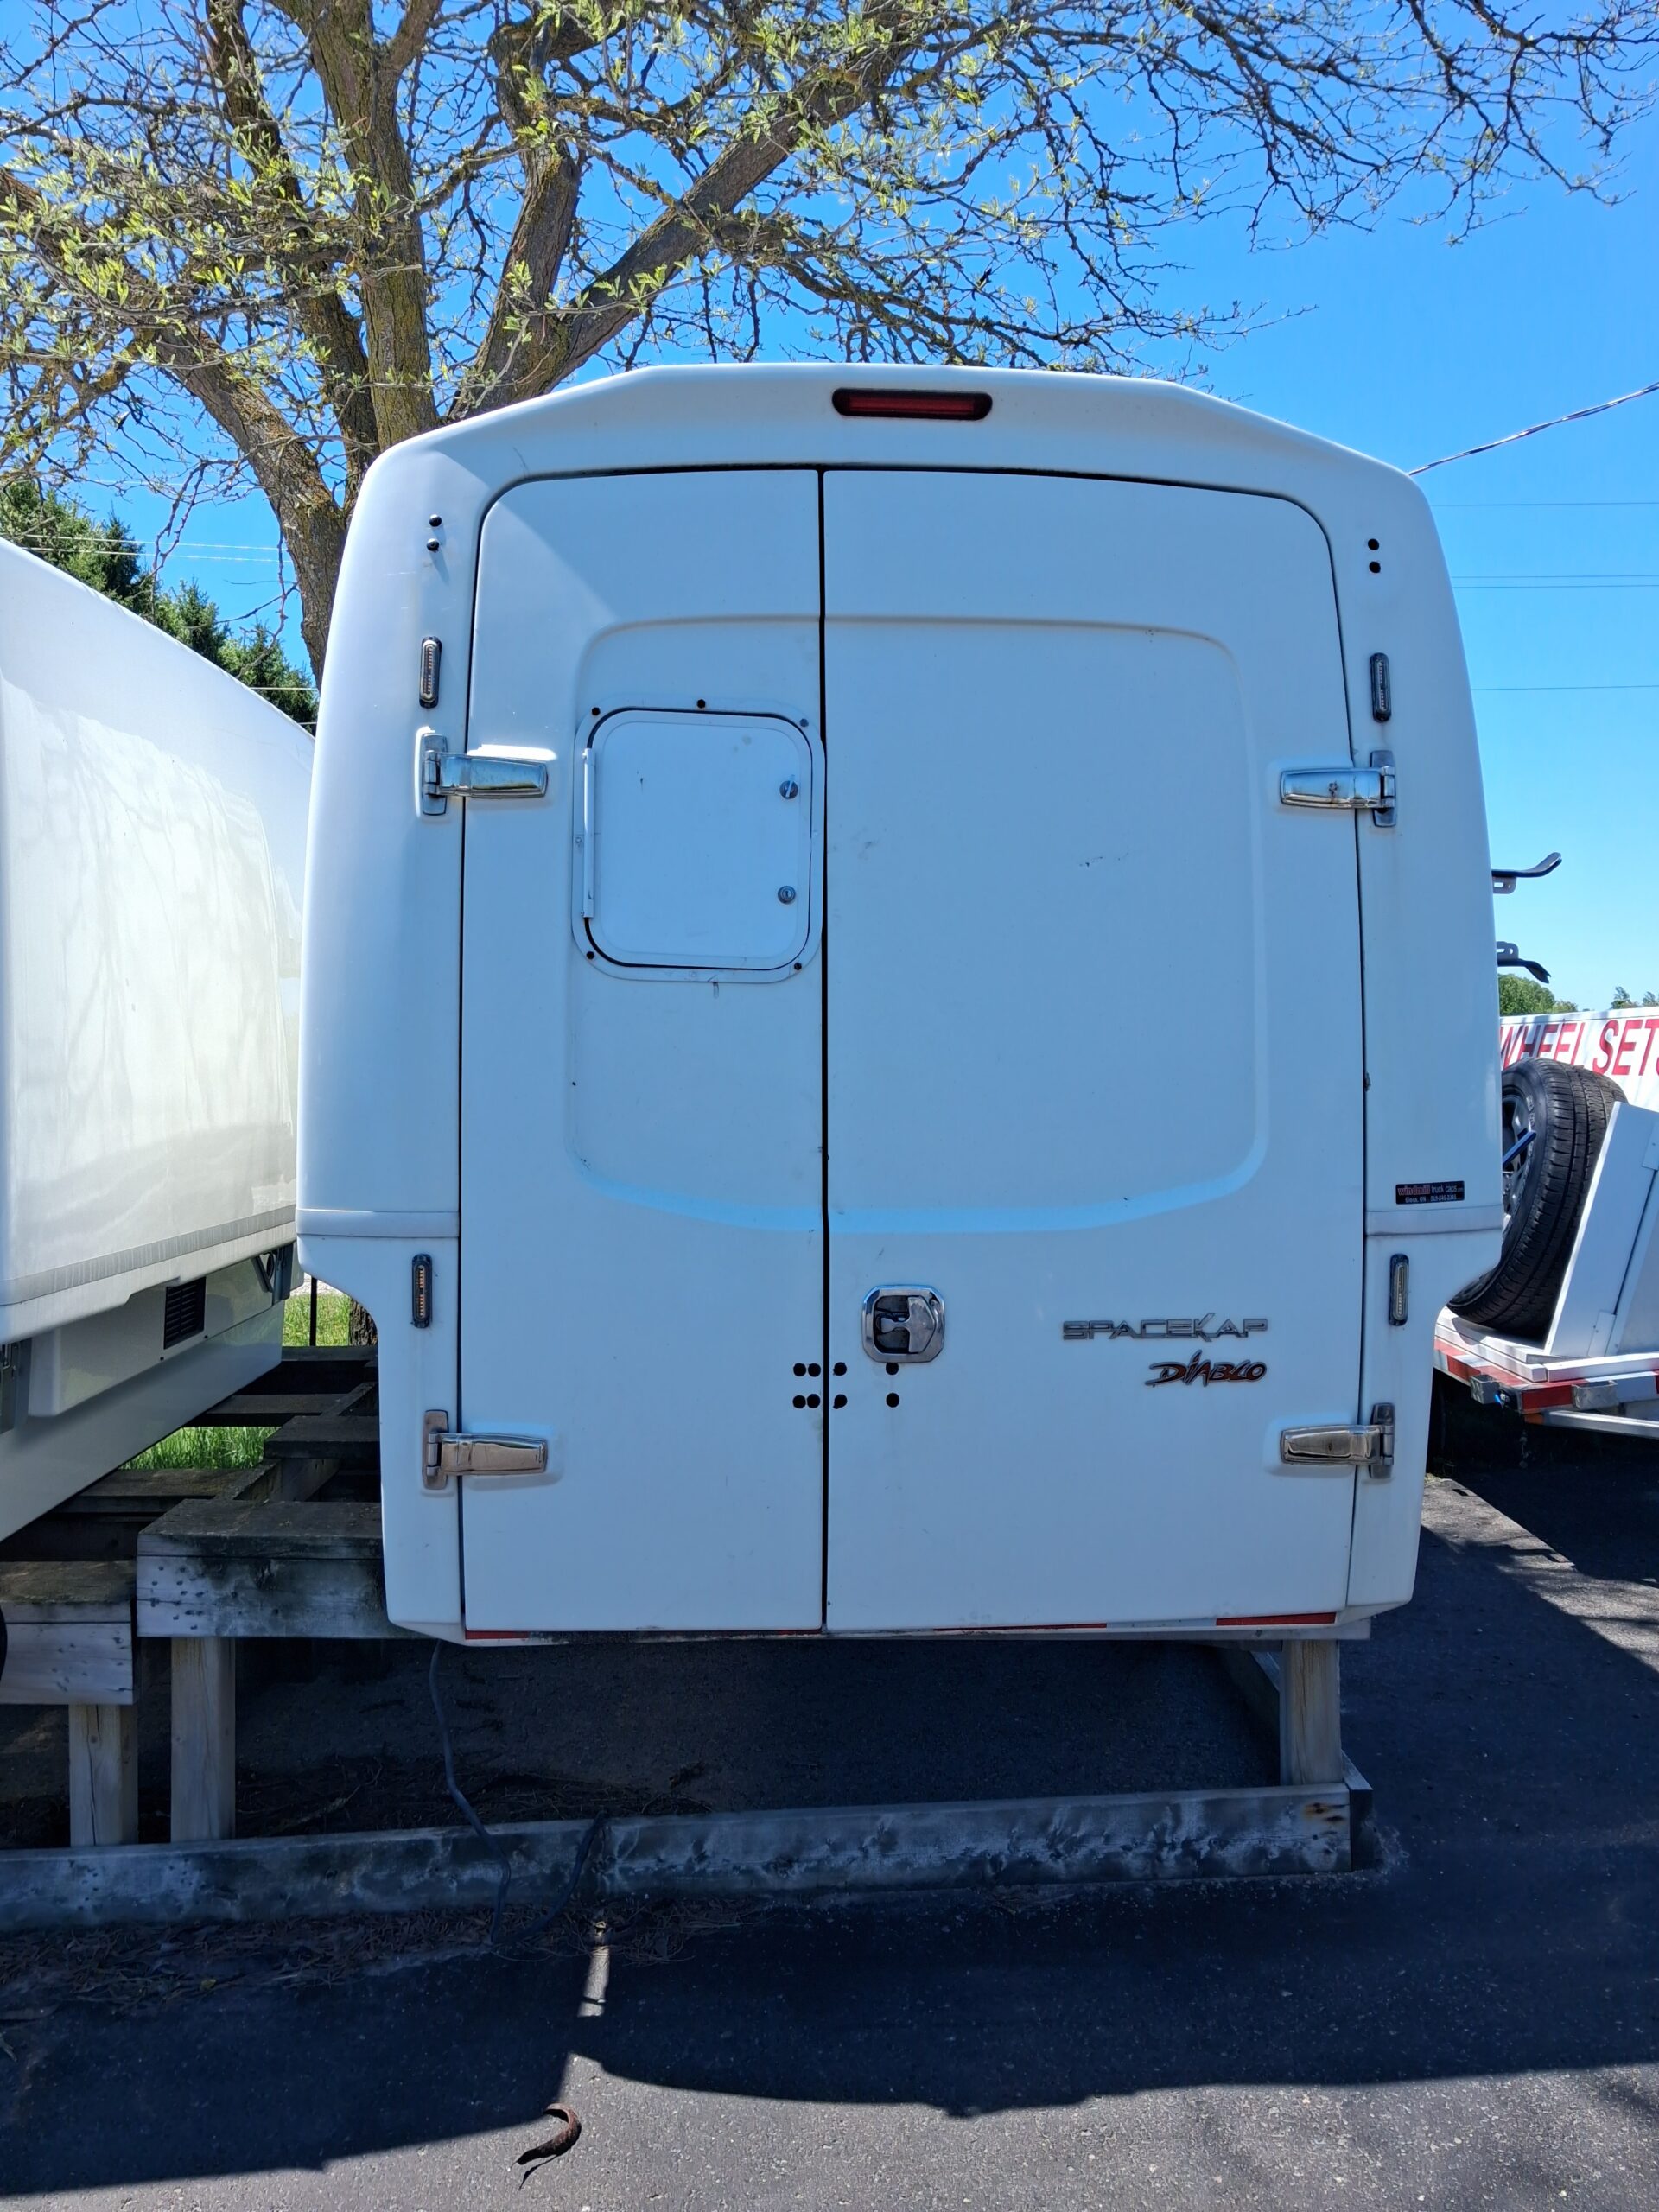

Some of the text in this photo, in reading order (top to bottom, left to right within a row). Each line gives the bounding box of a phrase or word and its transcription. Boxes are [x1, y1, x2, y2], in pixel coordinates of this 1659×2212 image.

[1592, 1019, 1659, 1077] SET
[1431, 1184, 1445, 1194] truck
[1062, 1313, 1268, 1342] SPACEKAP
